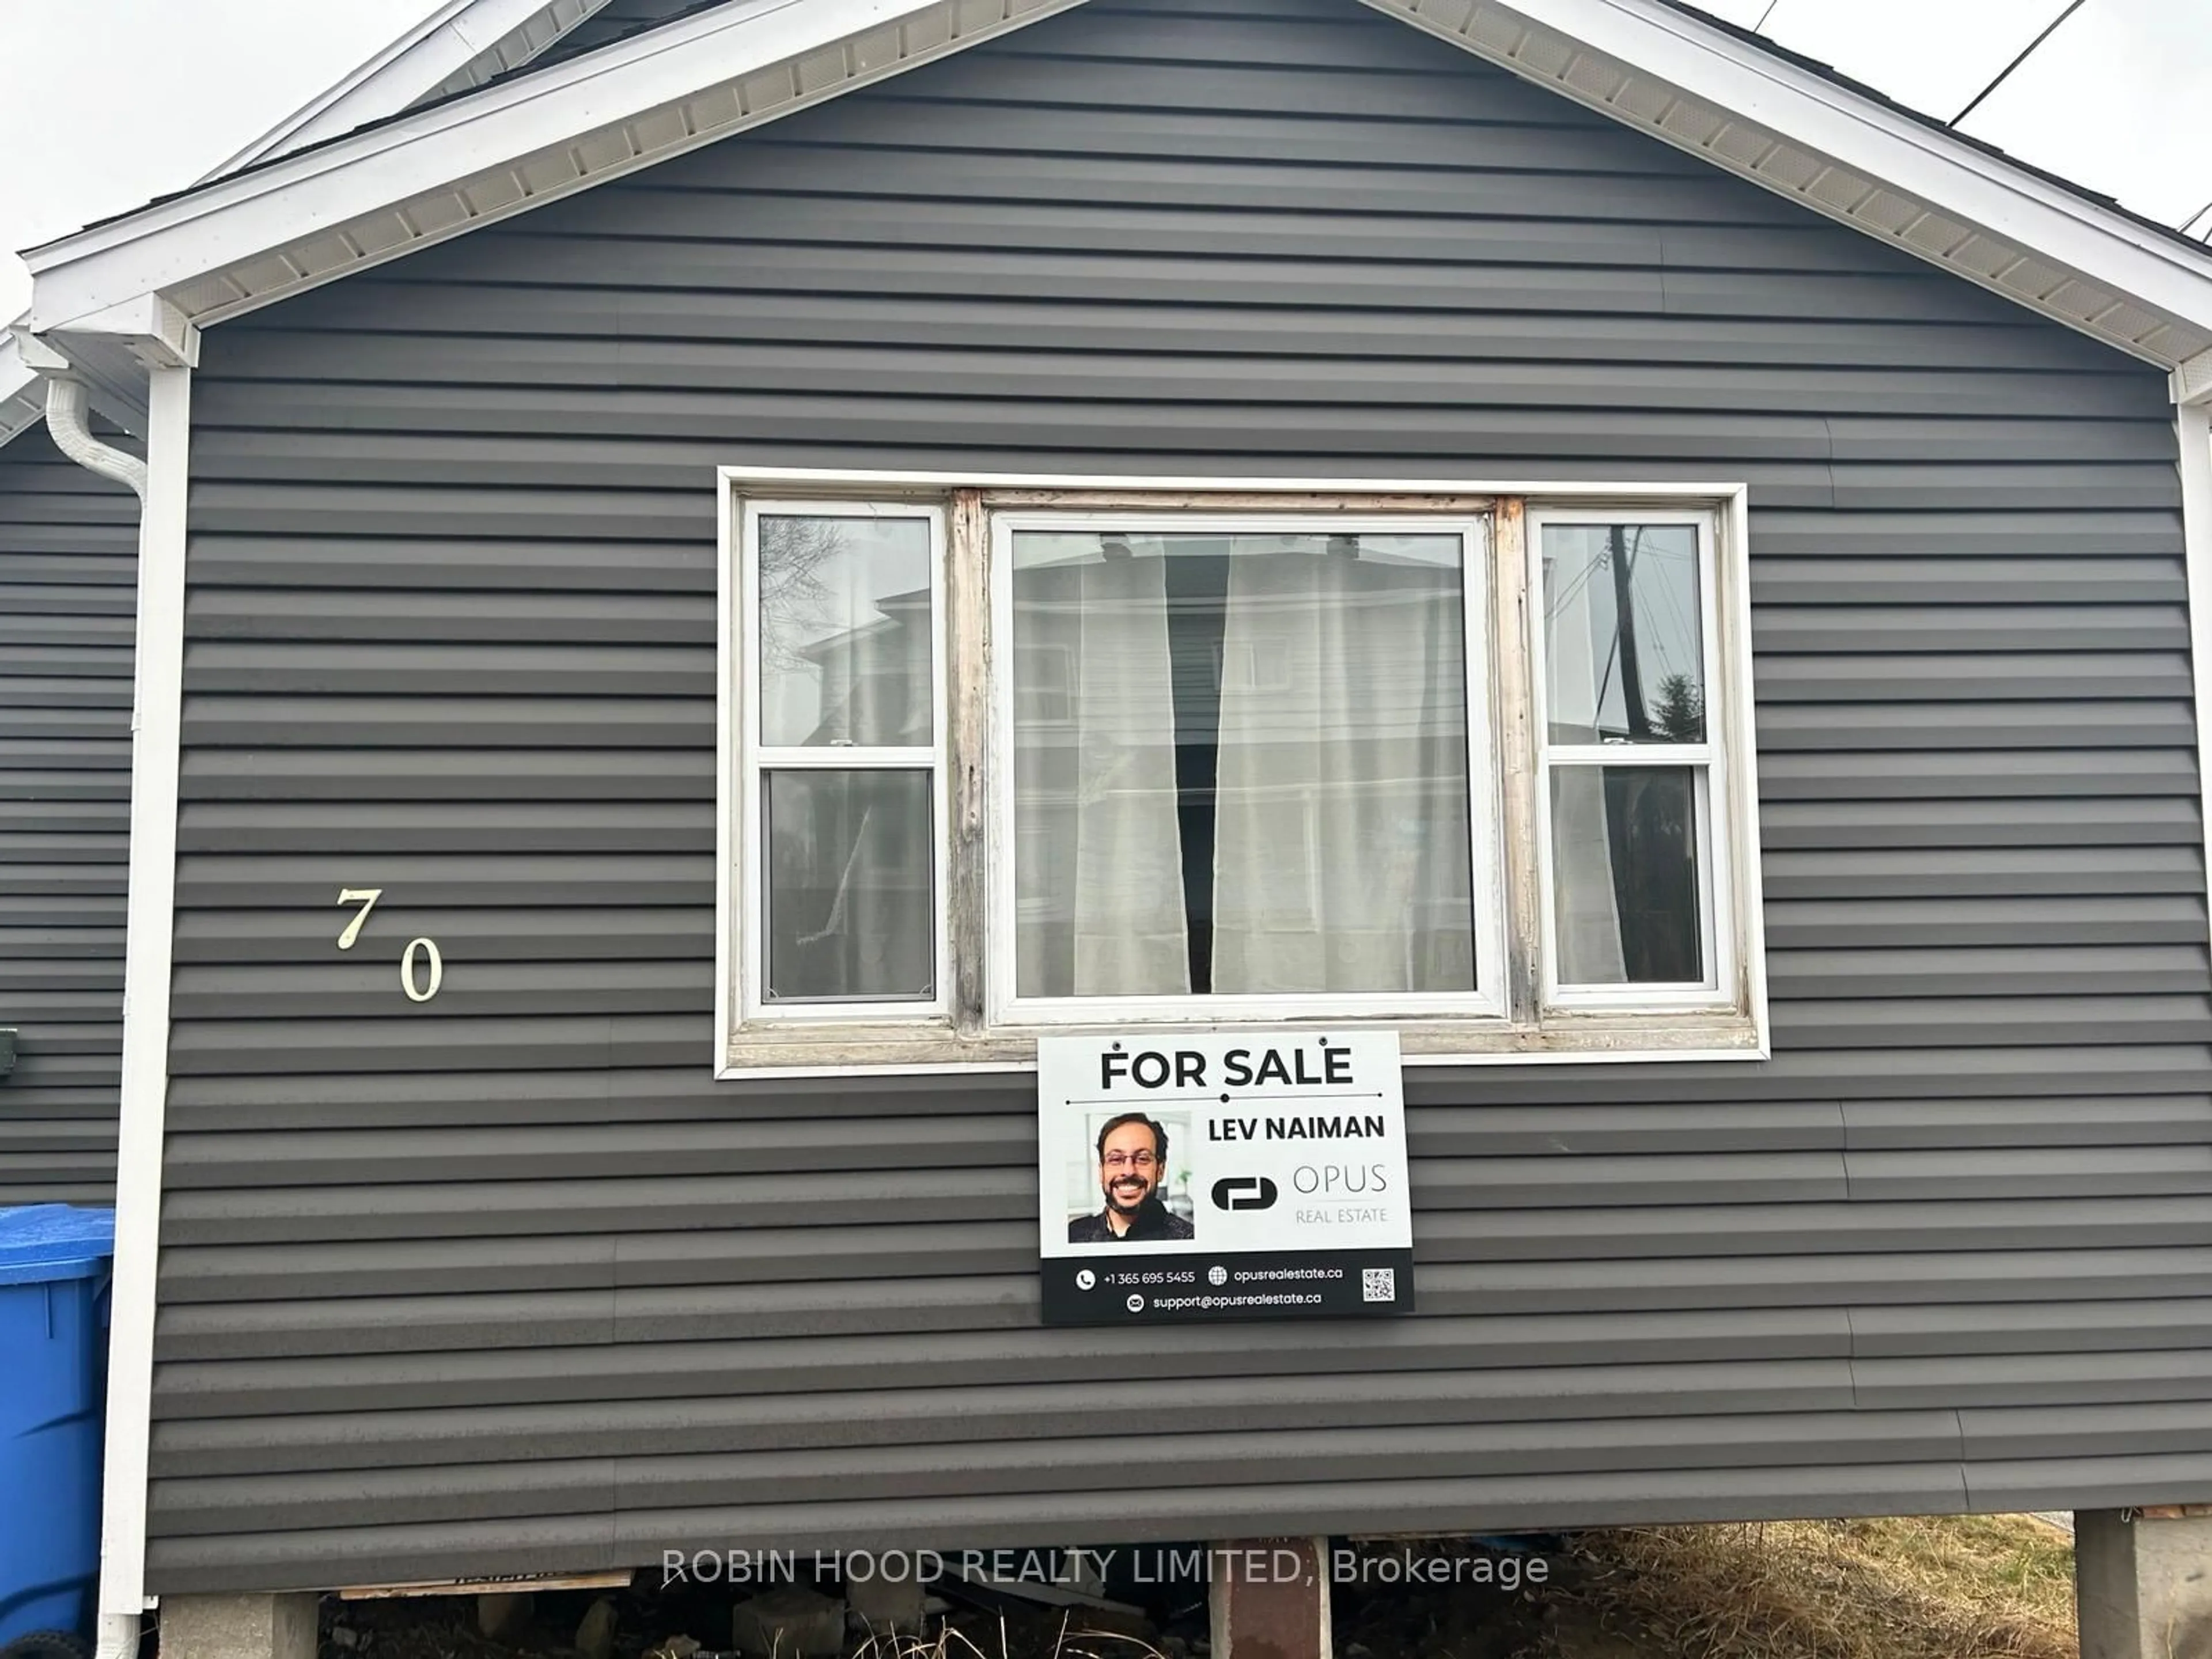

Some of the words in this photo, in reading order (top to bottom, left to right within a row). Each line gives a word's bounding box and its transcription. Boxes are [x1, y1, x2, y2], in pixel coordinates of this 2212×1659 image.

[1101, 1051, 1207, 1089] FOR
[1224, 1048, 1354, 1086] SALE
[1209, 1119, 1257, 1141] LEV
[1266, 1115, 1385, 1139] NAIMAN
[1293, 1164, 1387, 1193] OPUS
[1296, 1209, 1332, 1224] REAL
[1338, 1208, 1388, 1223] ESTATE
[1104, 1273, 1116, 1284] +1
[1118, 1272, 1140, 1284] 365
[1142, 1272, 1164, 1284] 695
[1166, 1271, 1196, 1283] 5455
[1234, 1267, 1343, 1283] opusrealestate.ca
[1154, 1293, 1322, 1310] support@opusrealestate.ca
